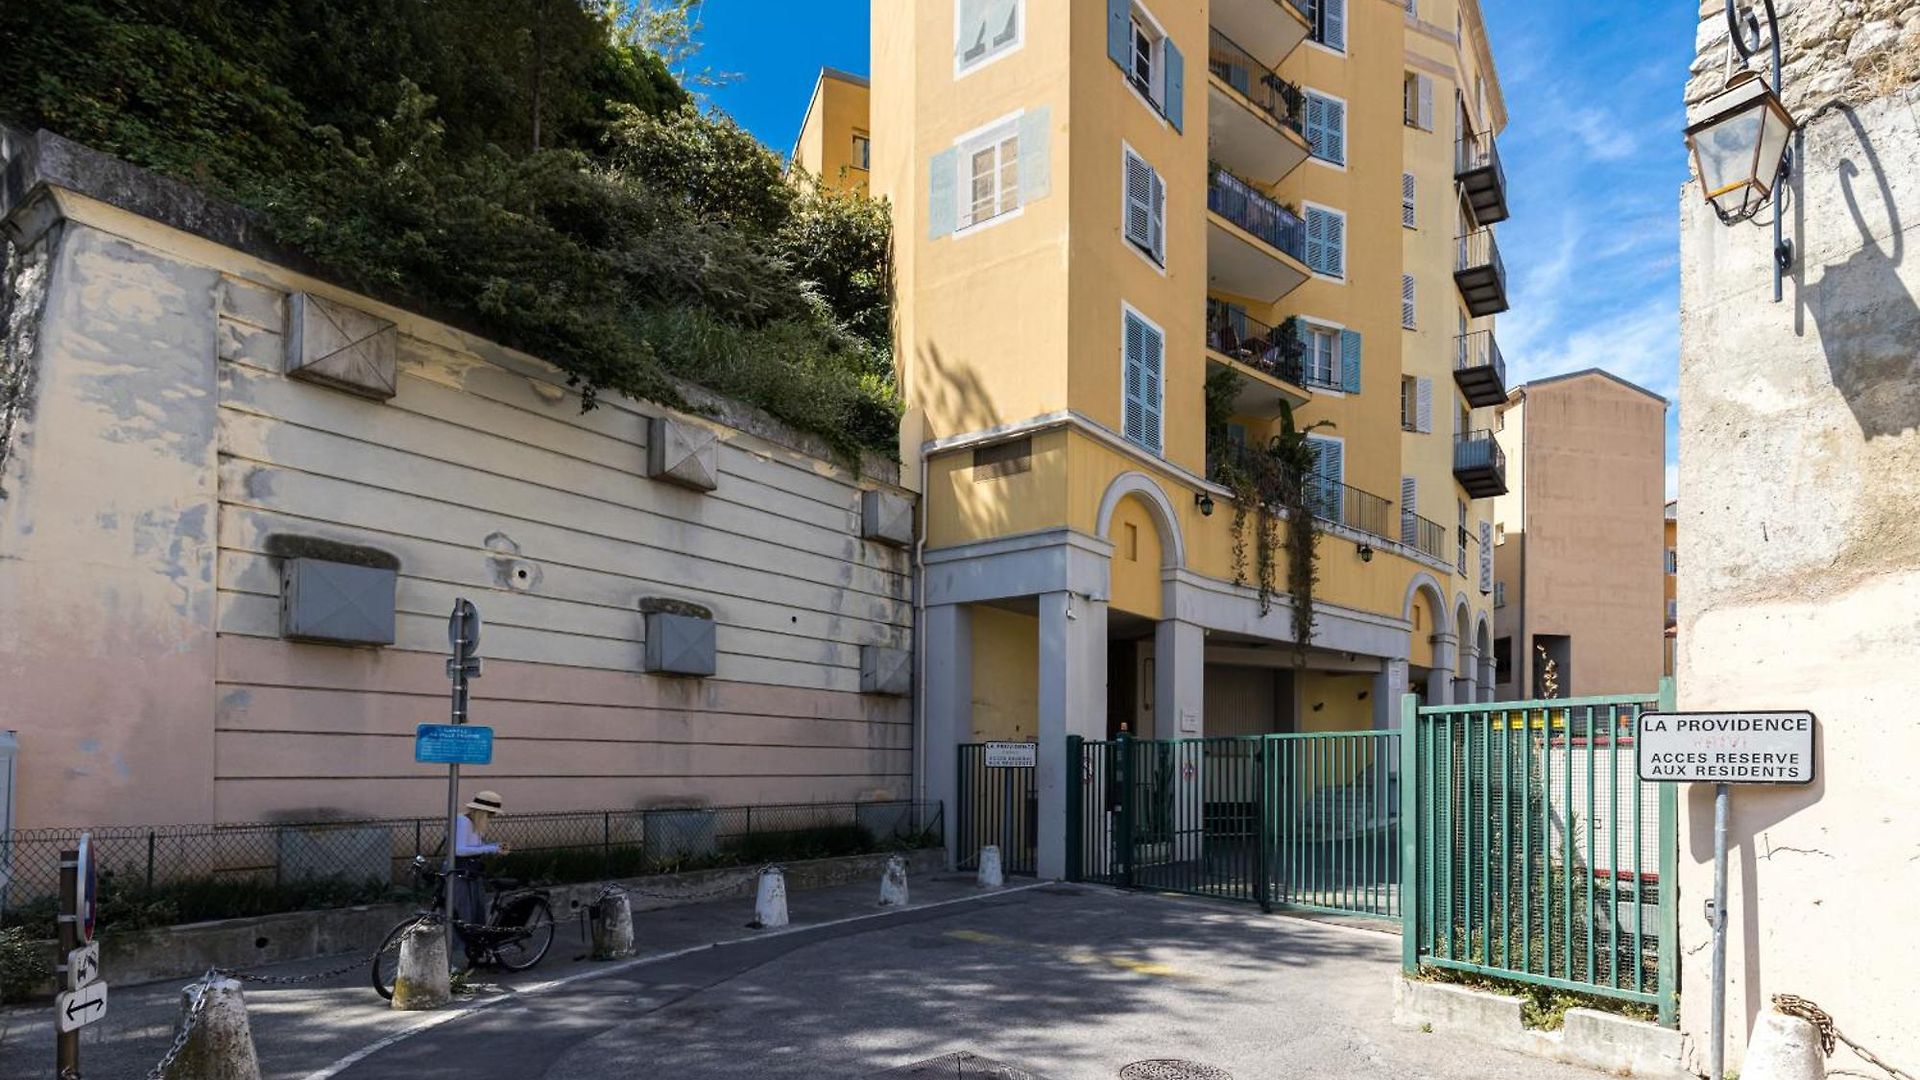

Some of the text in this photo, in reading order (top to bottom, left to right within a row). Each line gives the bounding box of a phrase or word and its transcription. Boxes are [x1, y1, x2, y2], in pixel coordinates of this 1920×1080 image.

[1644, 718, 1808, 732] LA PROVIDENCE
[1651, 753, 1800, 765] ACCES RESERVE
[1651, 765, 1800, 778] AUX RESIDENTS
